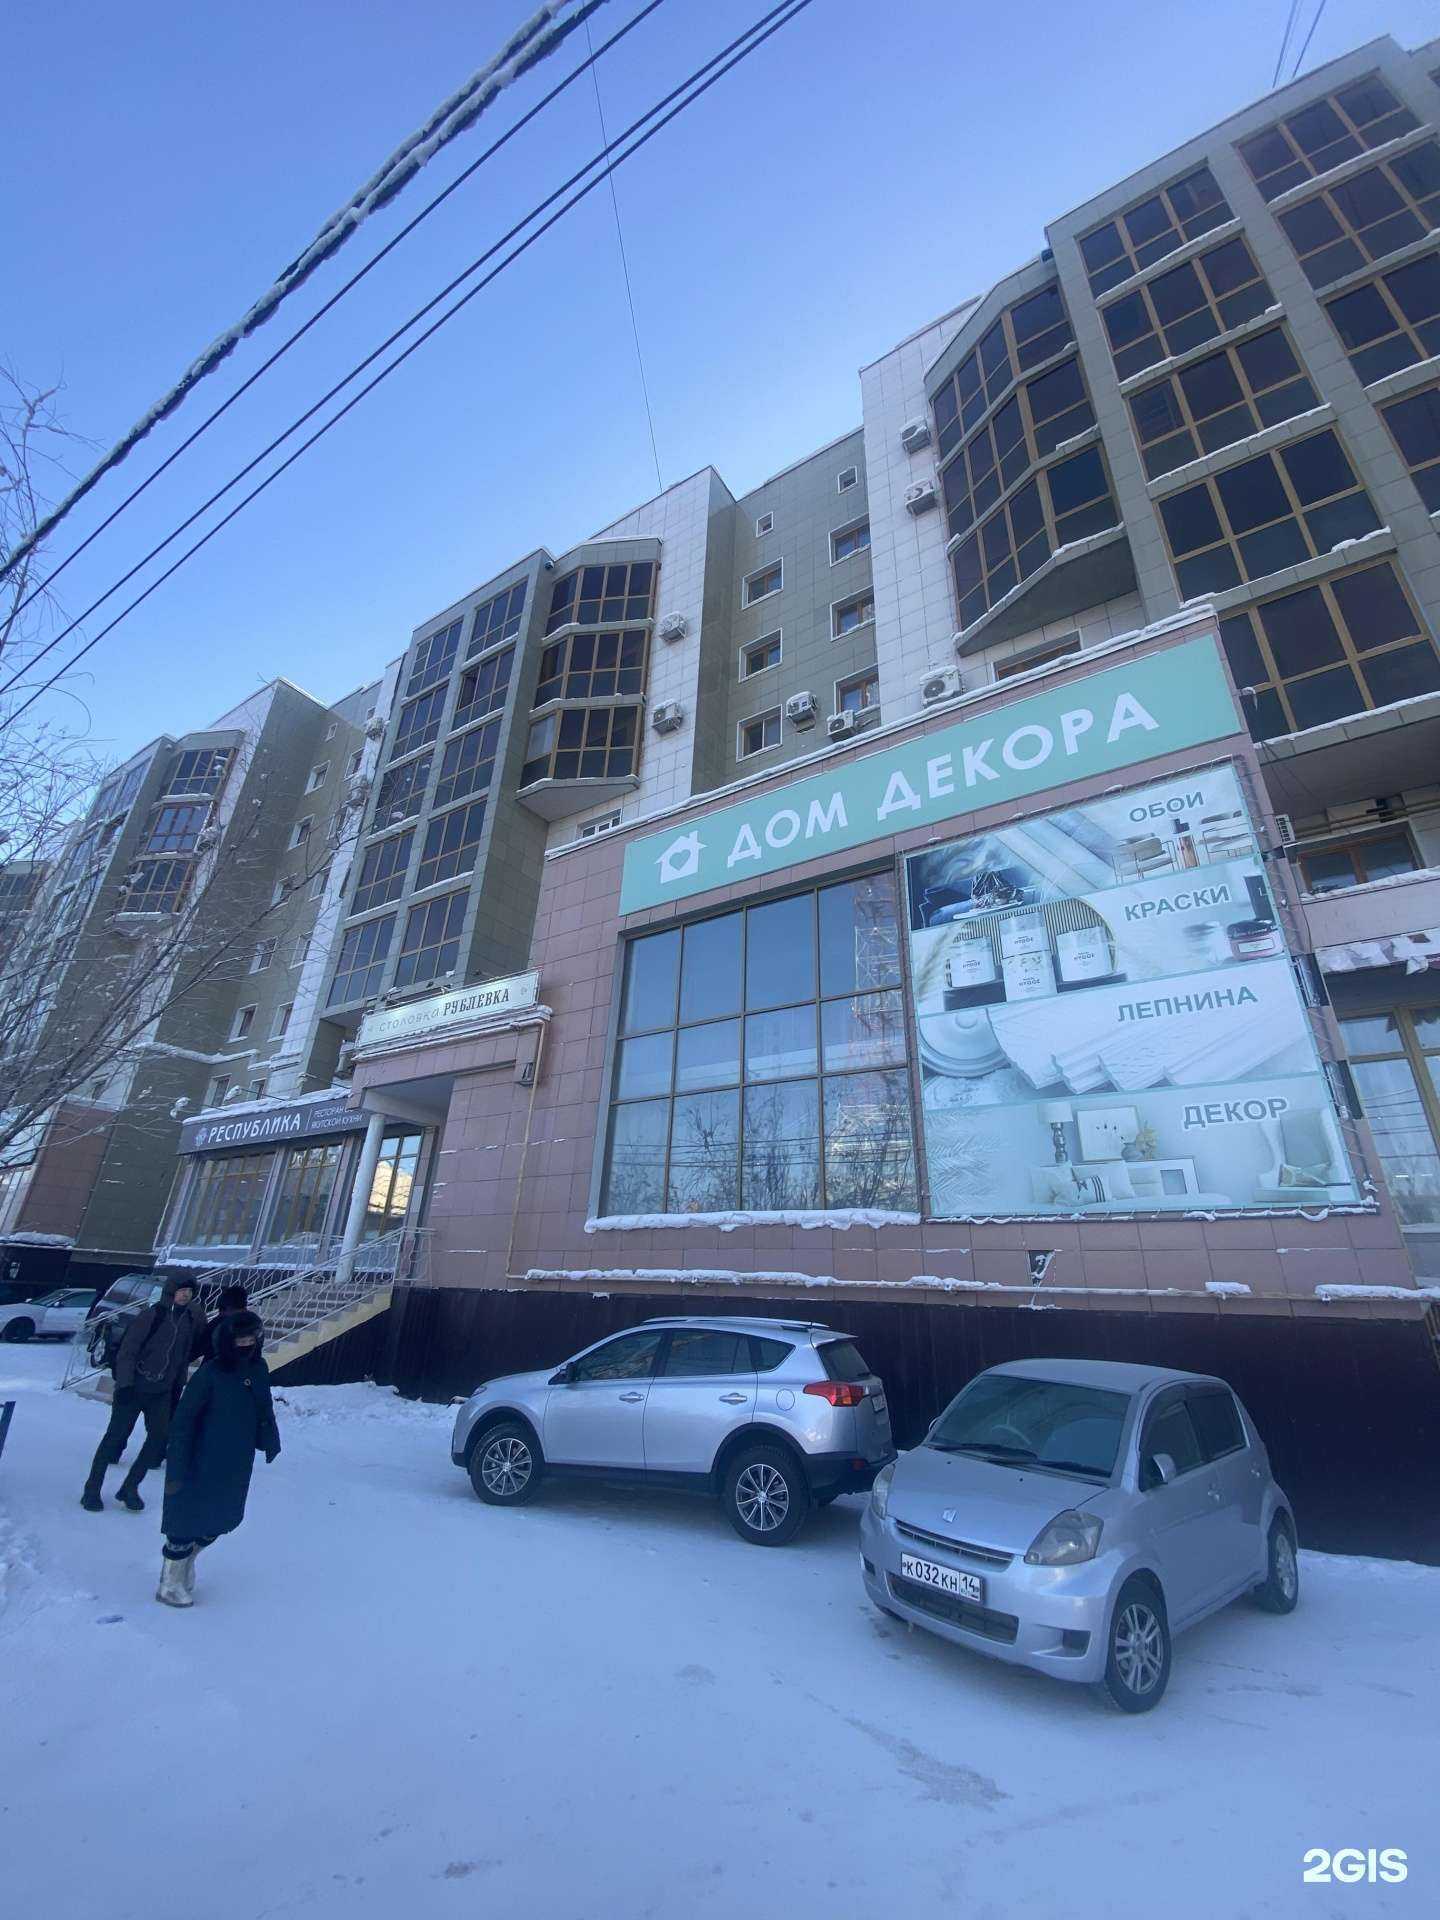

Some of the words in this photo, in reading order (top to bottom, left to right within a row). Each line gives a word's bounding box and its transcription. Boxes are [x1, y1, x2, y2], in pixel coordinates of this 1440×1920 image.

[726, 791, 849, 869] ДОМ
[877, 693, 1160, 821] ДЕКОРА
[1128, 791, 1205, 824] ОБОИ
[1124, 885, 1230, 921] КРАСКИ
[442, 988, 510, 1016] РУБЛЕВКА
[1117, 985, 1259, 1023] ЛЕПНИНА
[208, 1113, 301, 1143] РЕСПУБЛИКА
[1183, 1097, 1288, 1129] ДЕКОР
